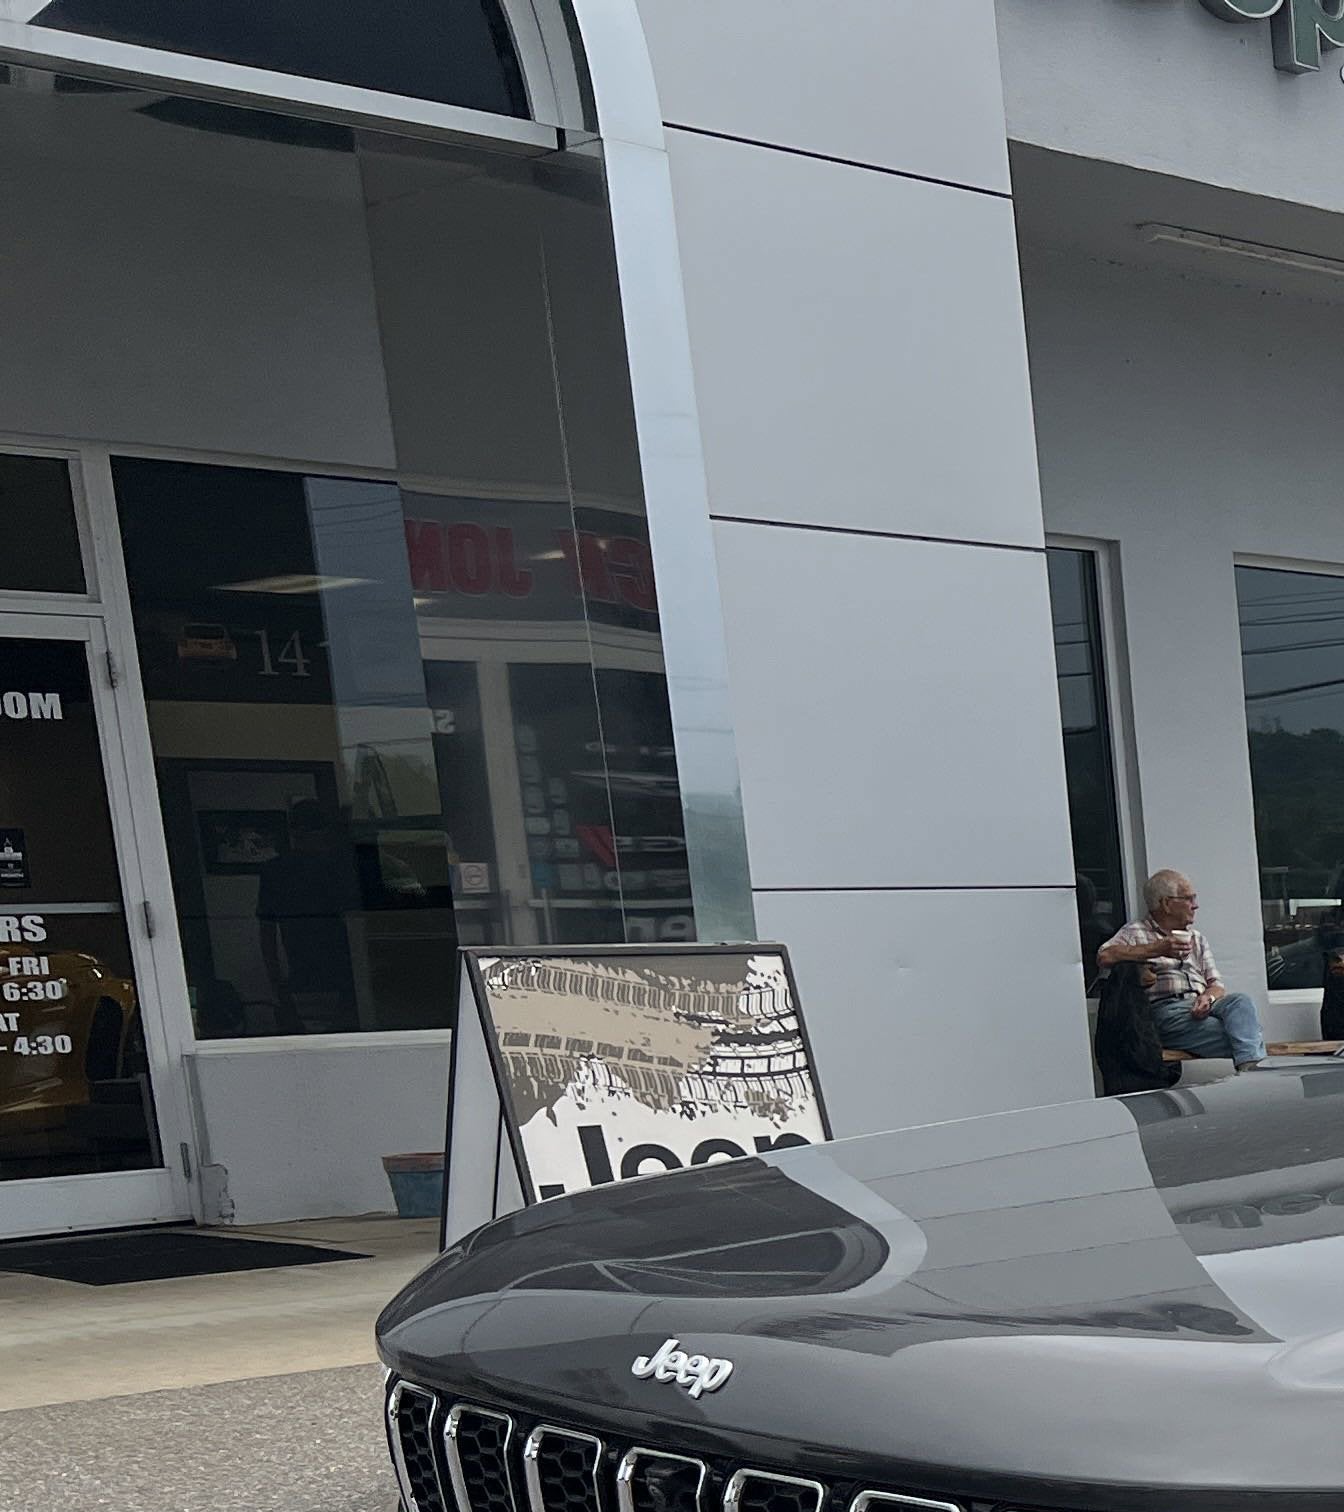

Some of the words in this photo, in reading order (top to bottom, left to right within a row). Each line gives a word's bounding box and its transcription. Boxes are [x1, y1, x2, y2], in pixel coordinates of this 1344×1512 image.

[8, 956, 50, 976] FRI
[2, 980, 63, 1001] 6:30
[14, 1034, 72, 1055] 4:30
[631, 1338, 735, 1399] Jeep
